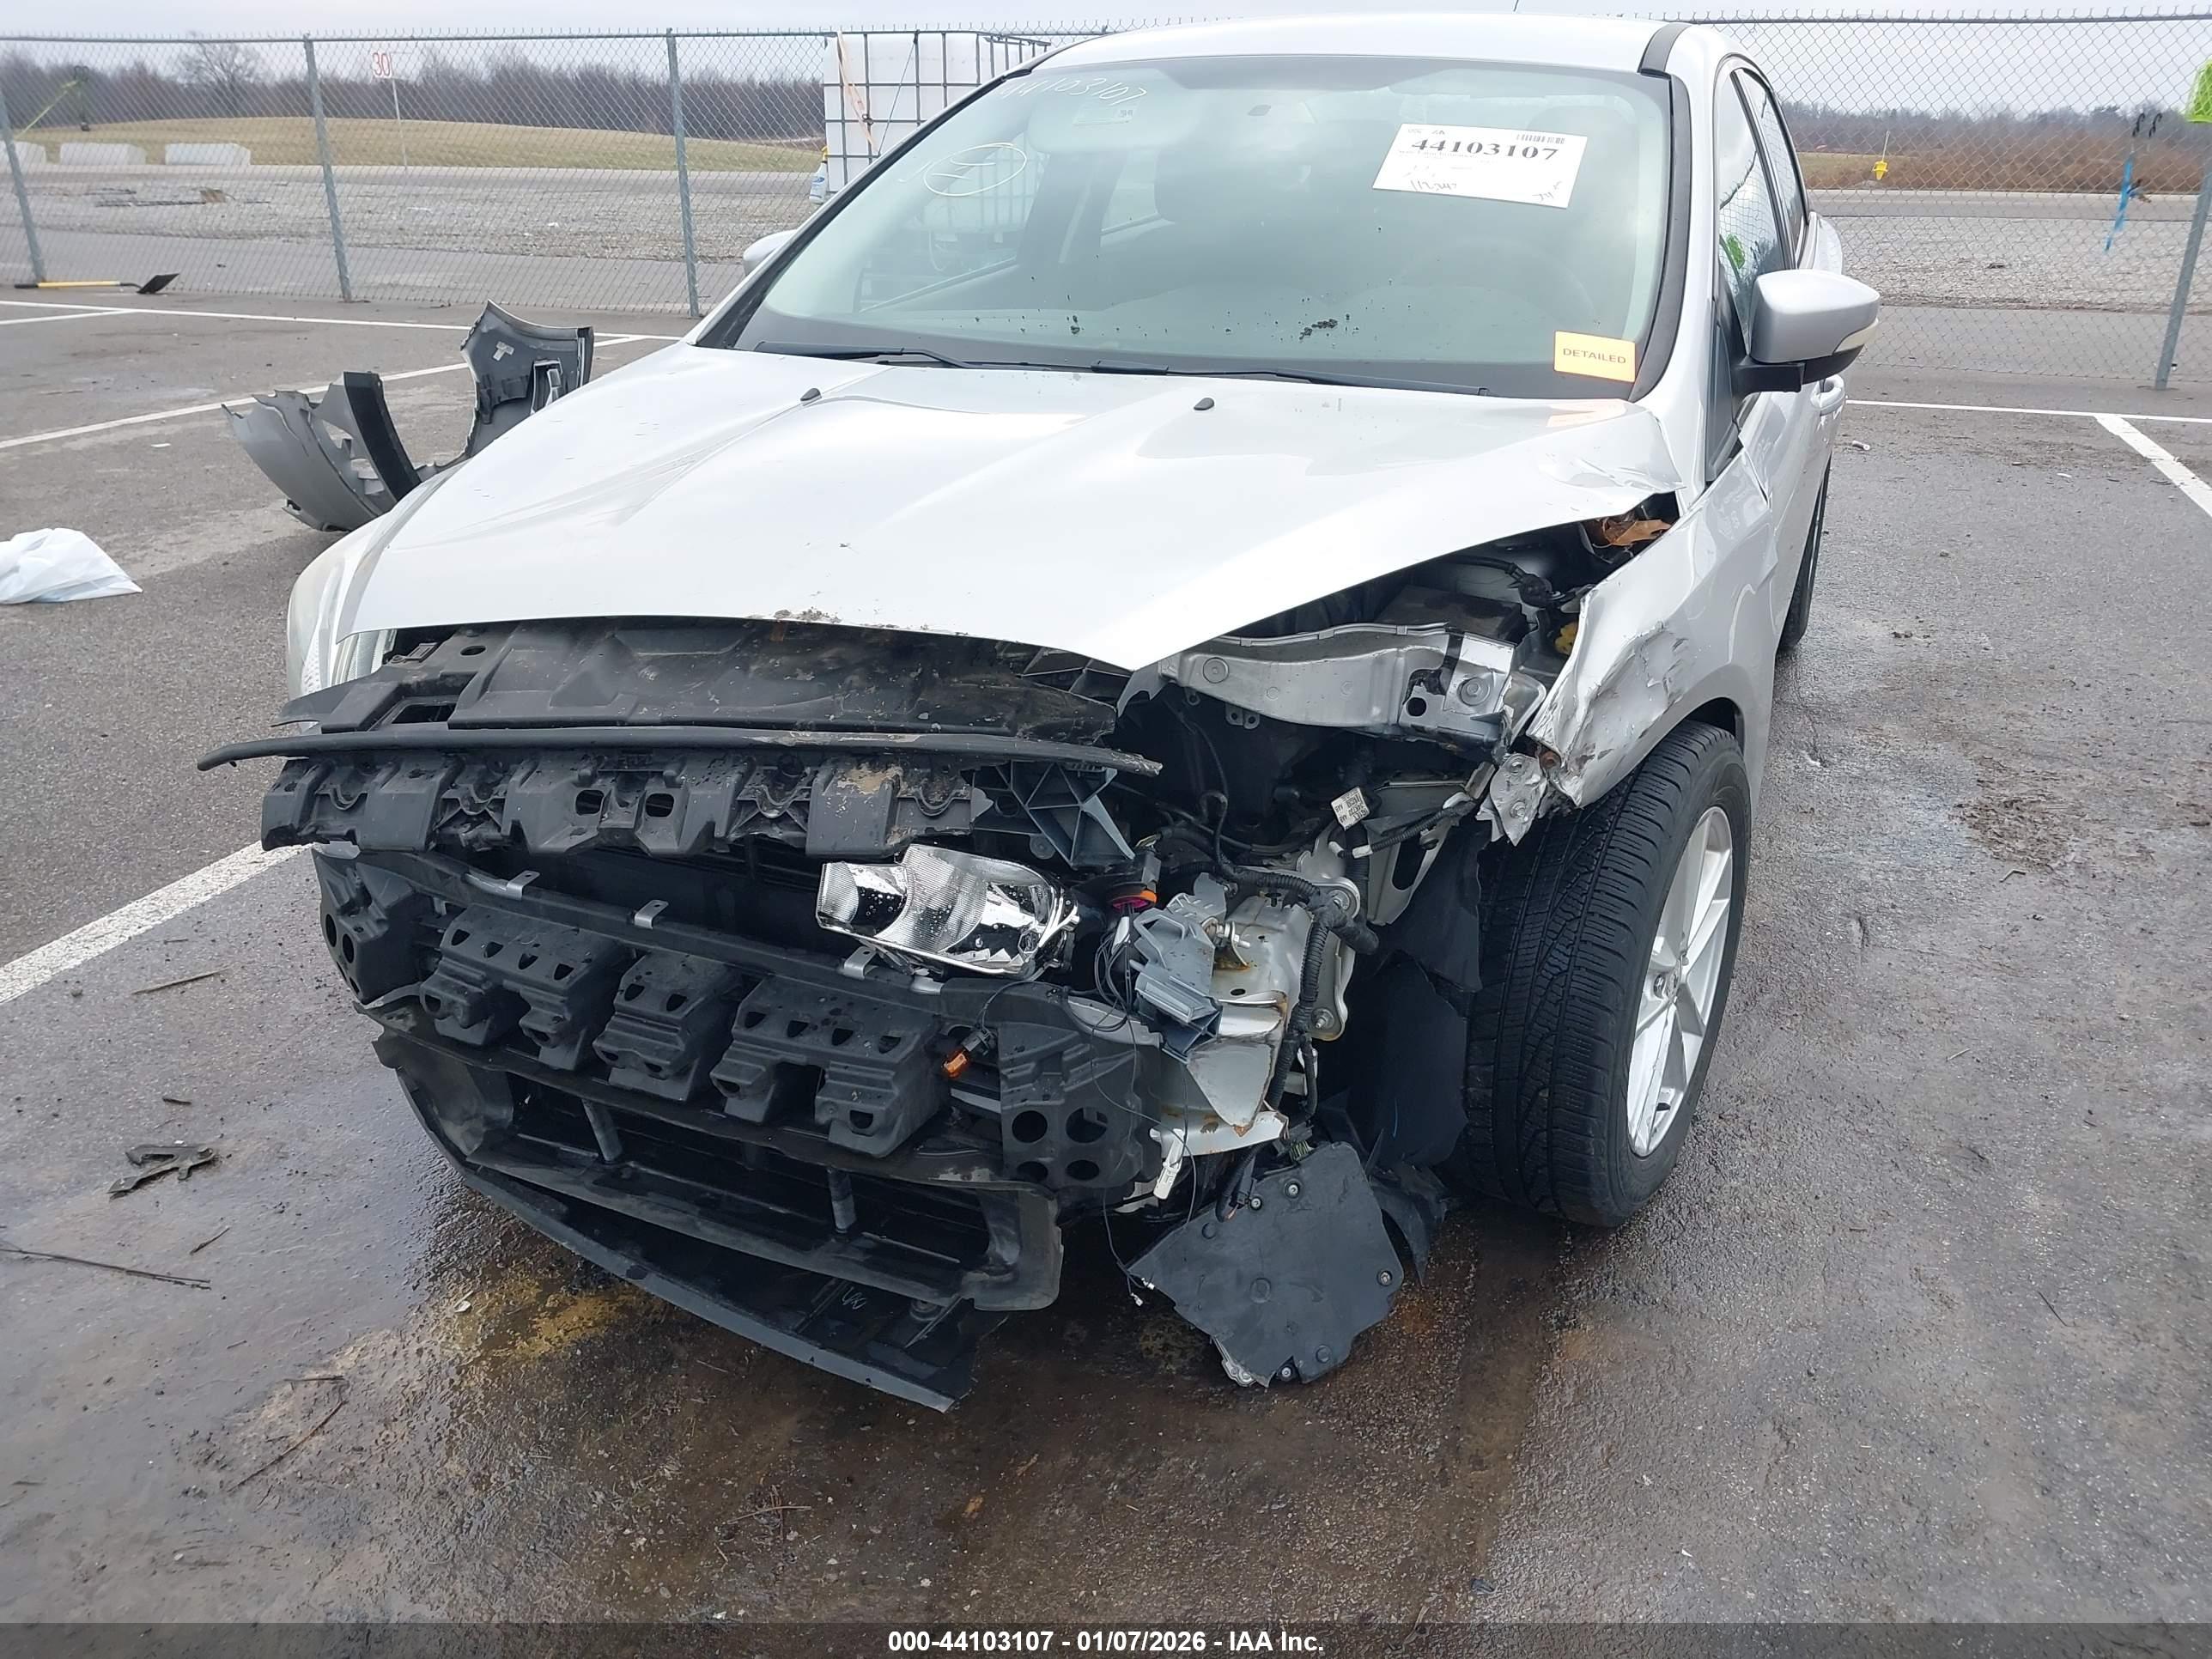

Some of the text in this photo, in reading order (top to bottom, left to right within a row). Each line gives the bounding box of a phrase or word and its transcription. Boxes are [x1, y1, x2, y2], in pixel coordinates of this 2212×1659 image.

[373, 52, 390, 76] 30
[1412, 139, 1559, 161] 44103107
[1563, 348, 1626, 364] DETAILED
